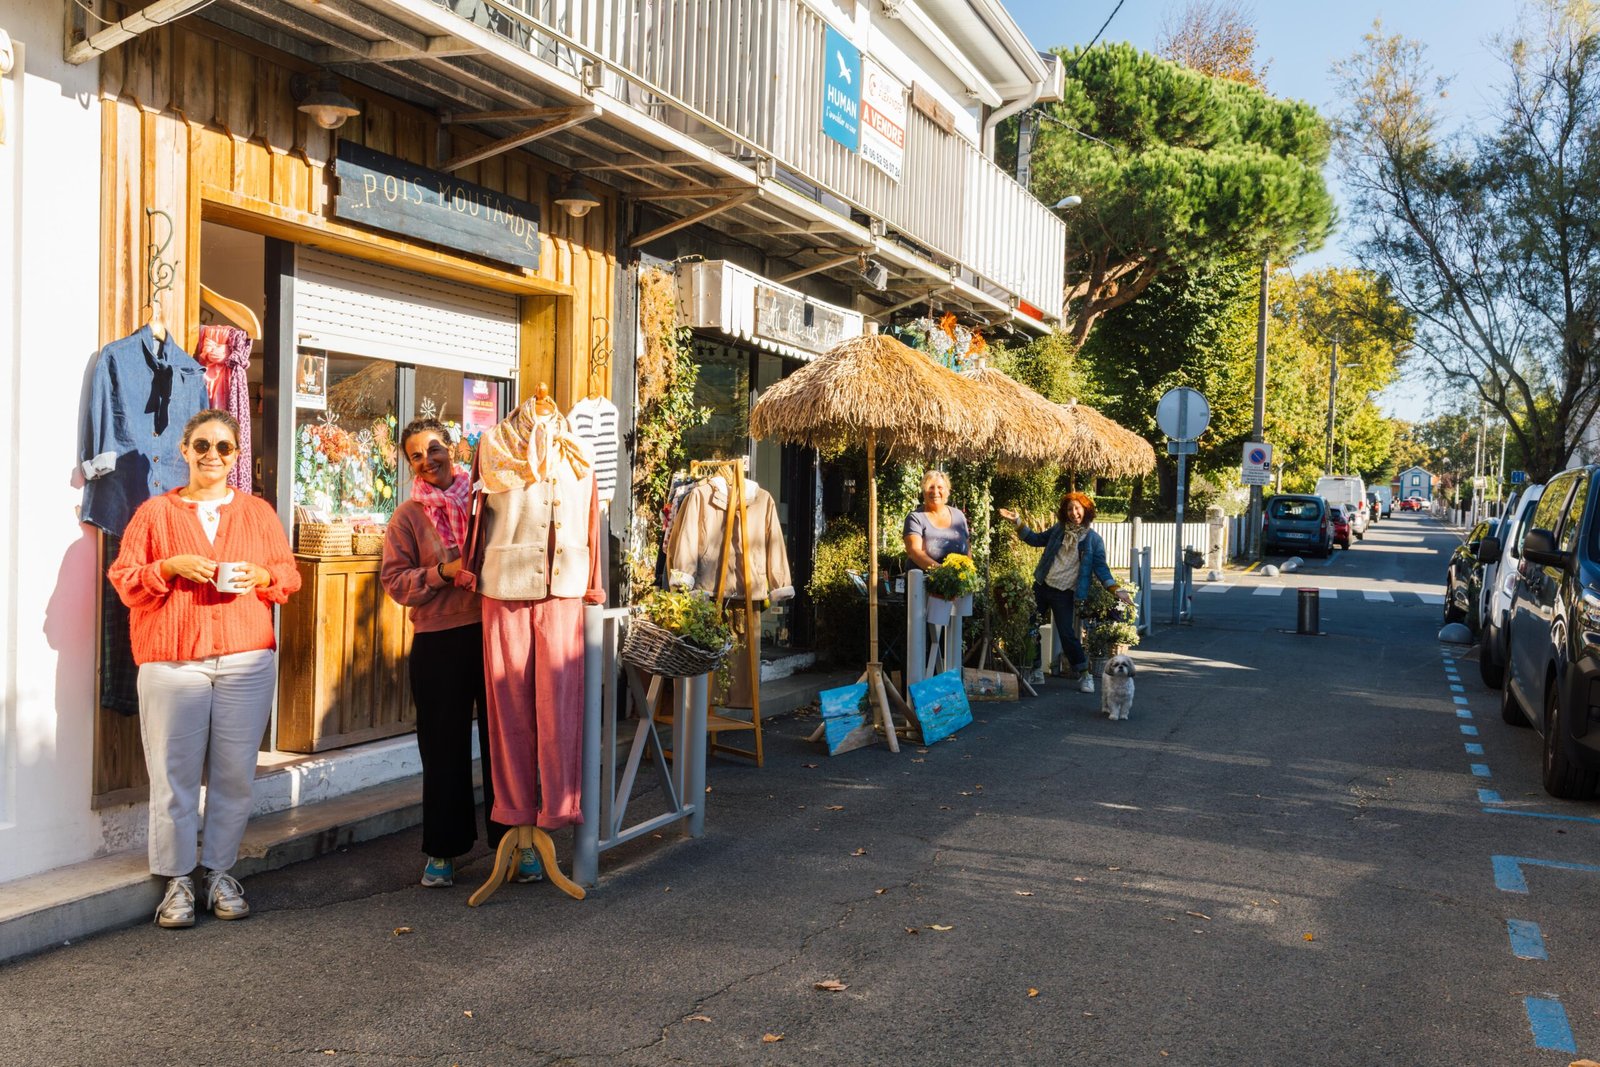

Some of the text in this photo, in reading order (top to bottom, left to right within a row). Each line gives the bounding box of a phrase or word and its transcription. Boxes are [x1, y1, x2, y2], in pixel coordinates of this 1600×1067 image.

[827, 84, 857, 120] HUMAN
[863, 104, 871, 123] A
[871, 108, 904, 147] VENDRE
[438, 181, 536, 251] MOUTARDE
